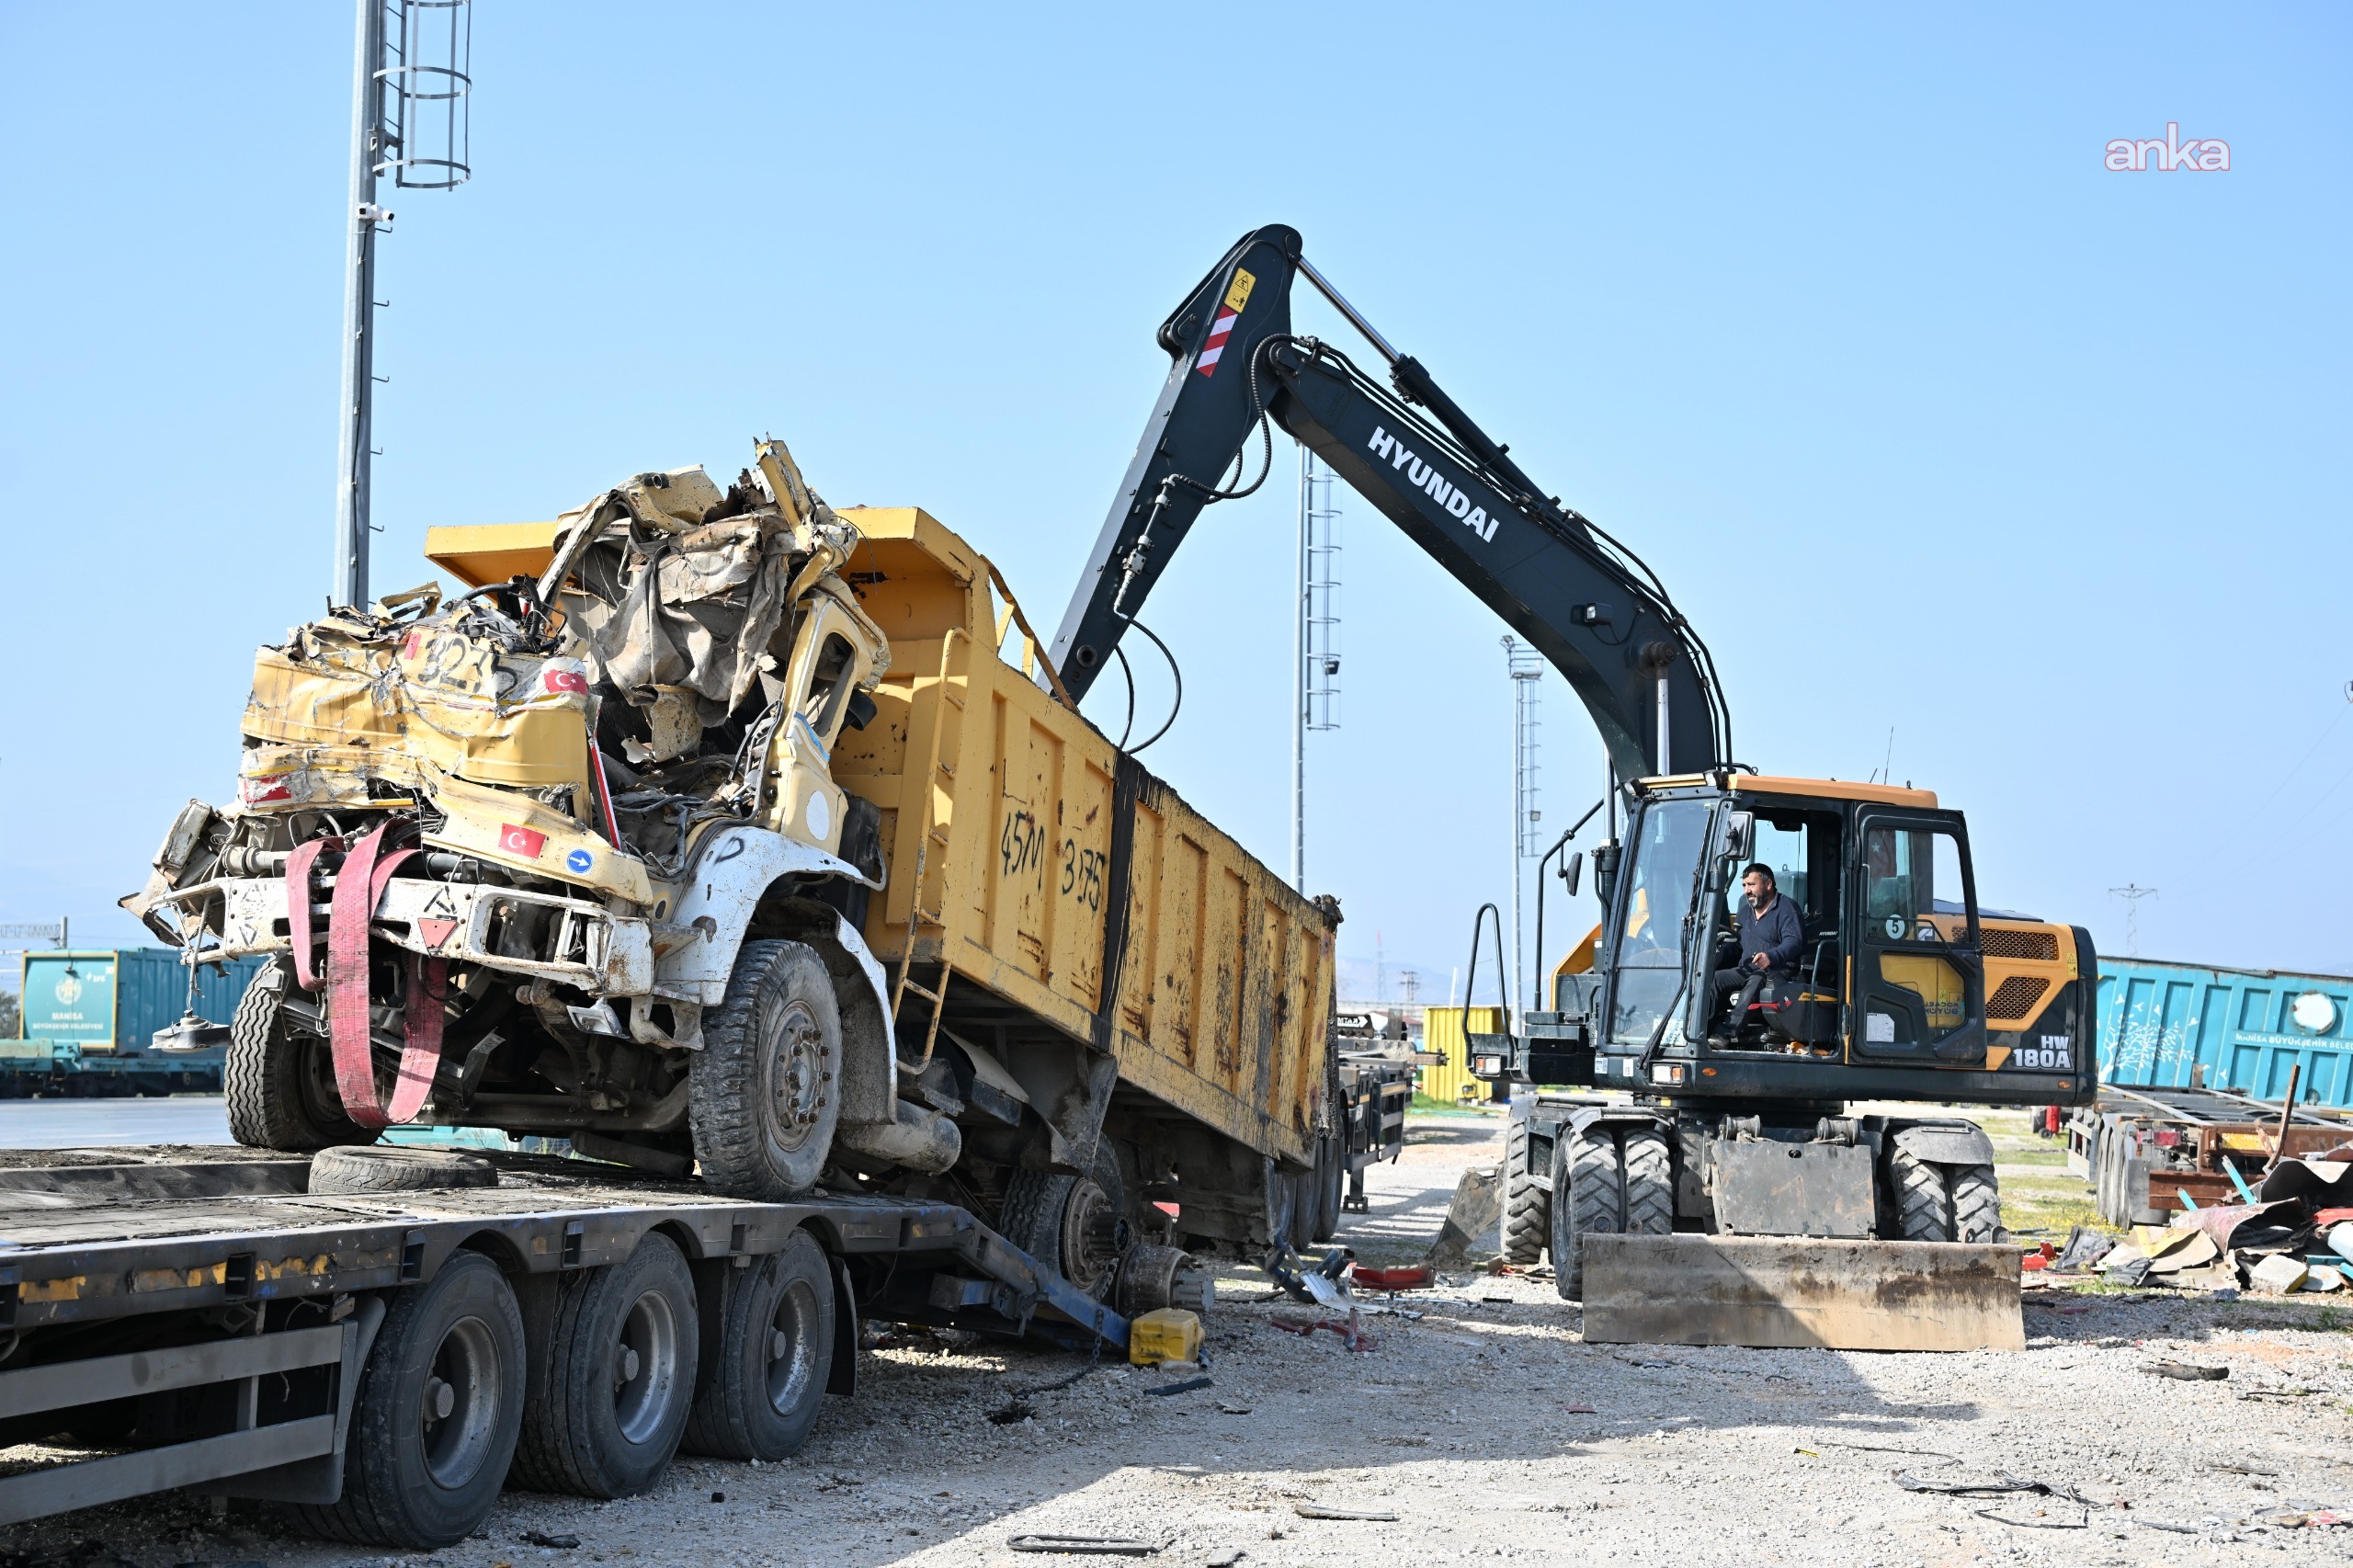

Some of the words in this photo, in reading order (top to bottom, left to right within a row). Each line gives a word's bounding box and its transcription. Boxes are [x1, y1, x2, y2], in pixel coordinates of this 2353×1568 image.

[1368, 426, 1499, 543] HYUNDAI
[1892, 919, 1899, 934] 5
[52, 1012, 83, 1020] MANİSA
[2041, 1036, 2069, 1050] HW
[2235, 1032, 2267, 1043] MANİSA
[2268, 1035, 2327, 1048] BÜYÜKŞEHİR
[2013, 1049, 2070, 1068] 180A
